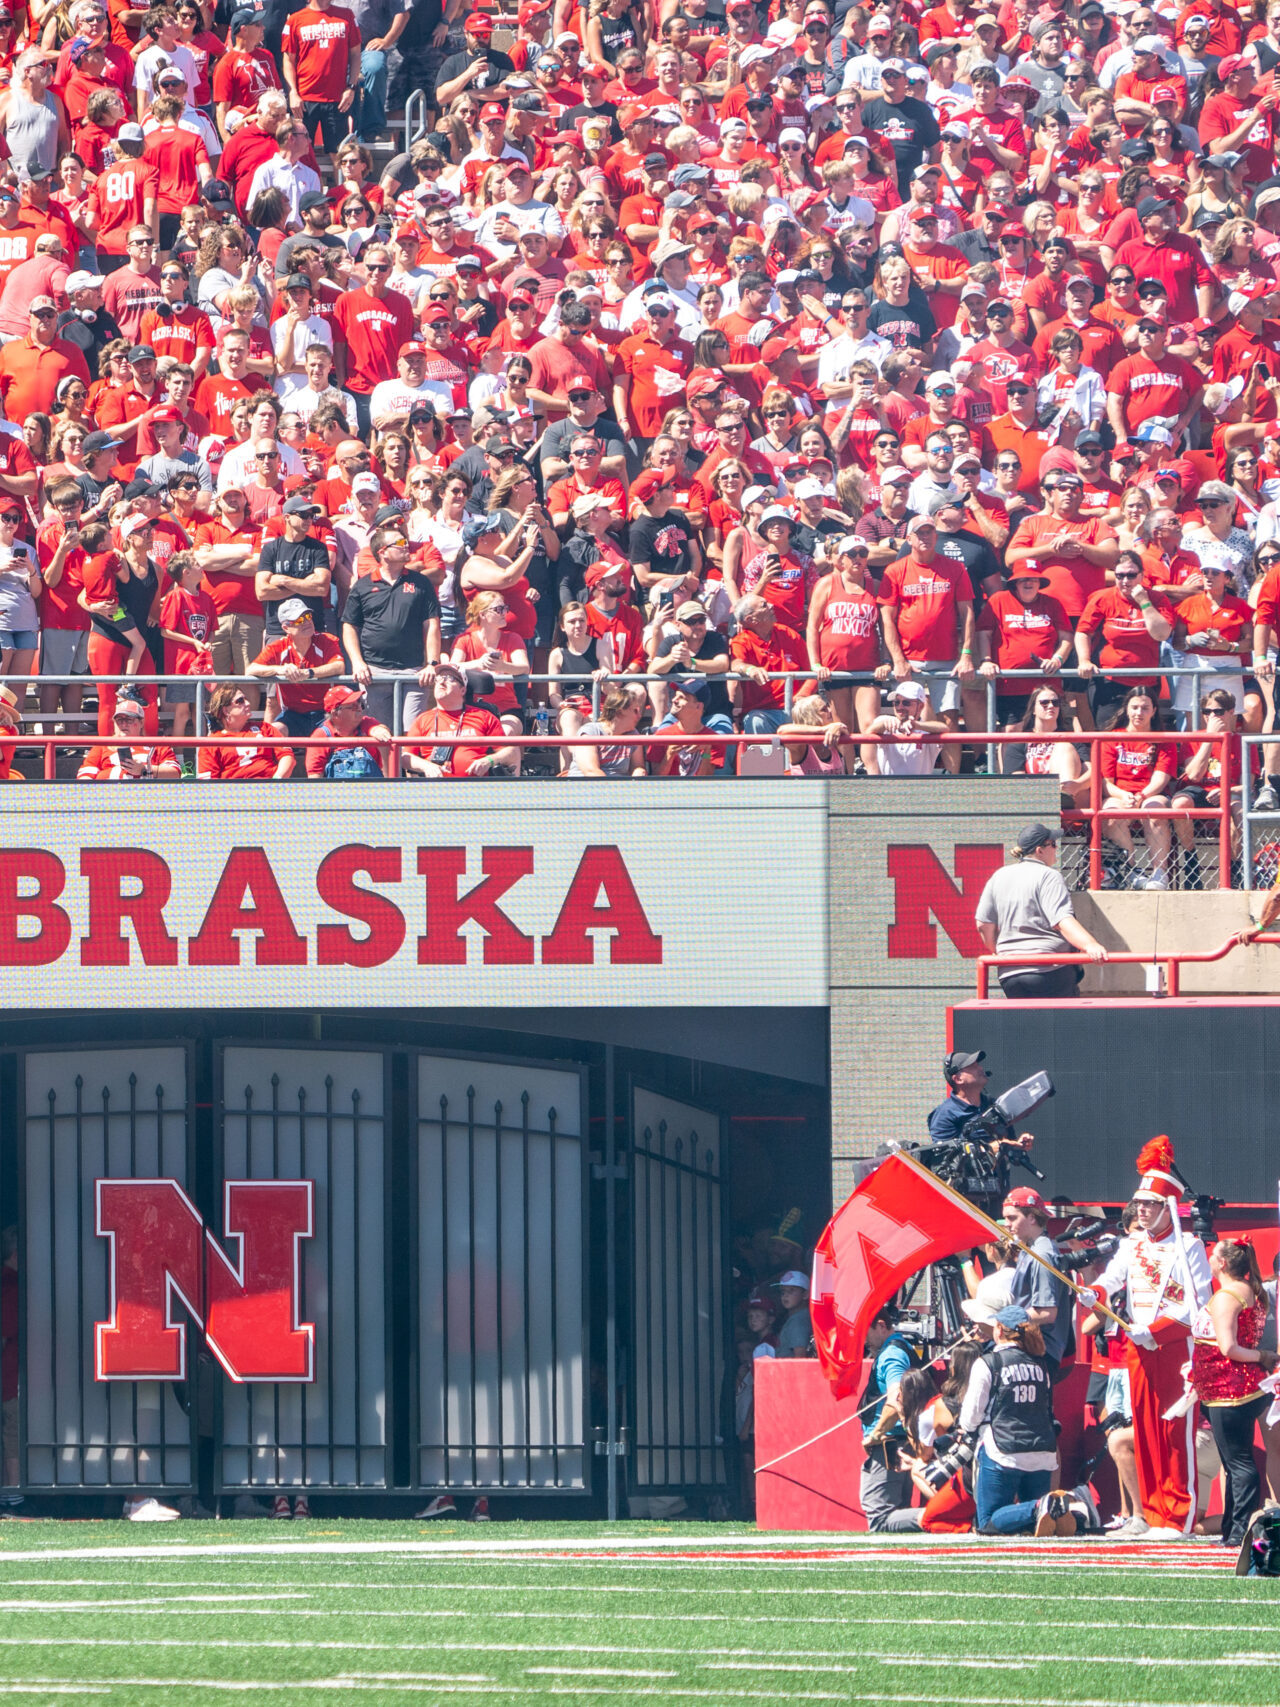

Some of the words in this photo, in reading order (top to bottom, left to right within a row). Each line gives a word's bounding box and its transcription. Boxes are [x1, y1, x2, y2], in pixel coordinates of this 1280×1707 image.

[300, 22, 346, 34] NEBRASKA
[302, 30, 346, 42] HUSKERS
[107, 171, 136, 202] 80
[356, 311, 398, 325] NEBRASKA
[151, 325, 196, 343] NEBRASKA
[877, 320, 921, 337] NEBRASKA
[893, 334, 907, 347] N
[992, 361, 1009, 377] N
[575, 376, 583, 385] N
[1130, 372, 1183, 391] NEBRASKA
[404, 582, 415, 593] N
[888, 844, 1005, 959] N
[94, 1178, 316, 1383] N
[1000, 1363, 1044, 1386] PHOTO
[1013, 1385, 1036, 1403] 130
